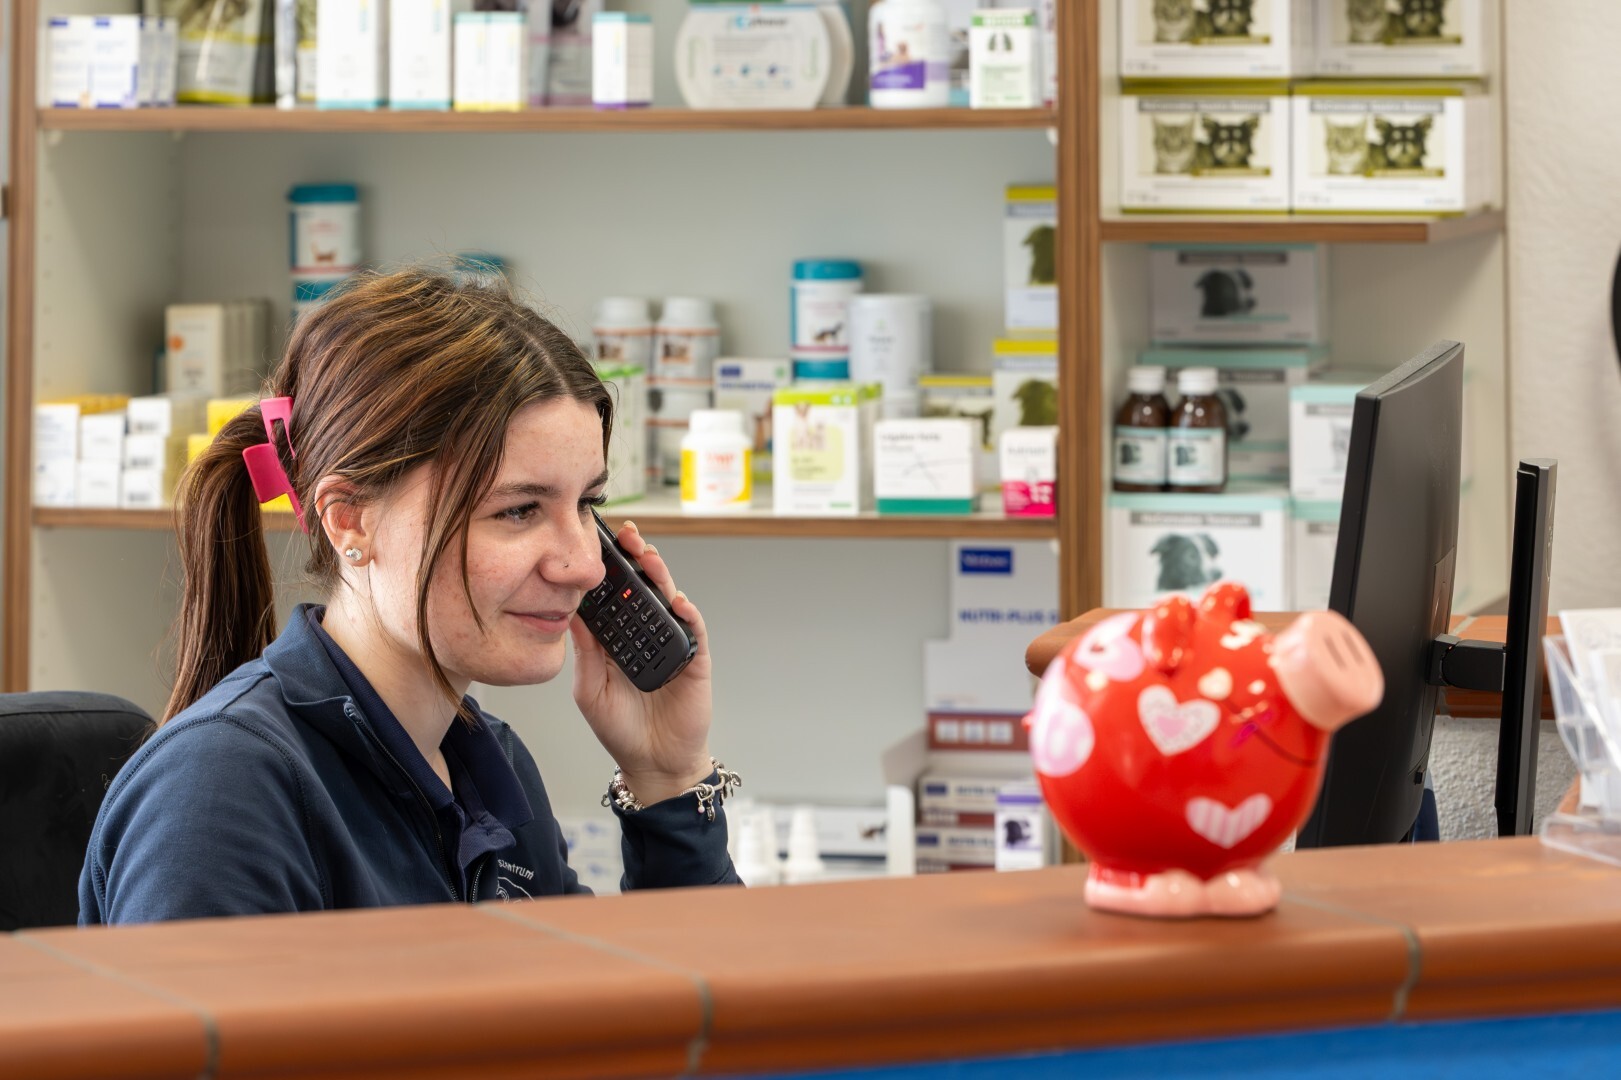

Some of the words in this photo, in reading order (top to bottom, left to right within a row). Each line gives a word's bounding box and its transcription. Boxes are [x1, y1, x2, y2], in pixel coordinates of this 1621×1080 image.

[616, 618, 625, 627] 2
[631, 602, 639, 611] 3
[612, 644, 619, 652] 4
[625, 629, 633, 638] 5
[640, 613, 648, 622] 6
[620, 655, 627, 665] 7
[634, 640, 642, 649] 8
[649, 624, 656, 633] 9
[644, 651, 651, 660] 0
